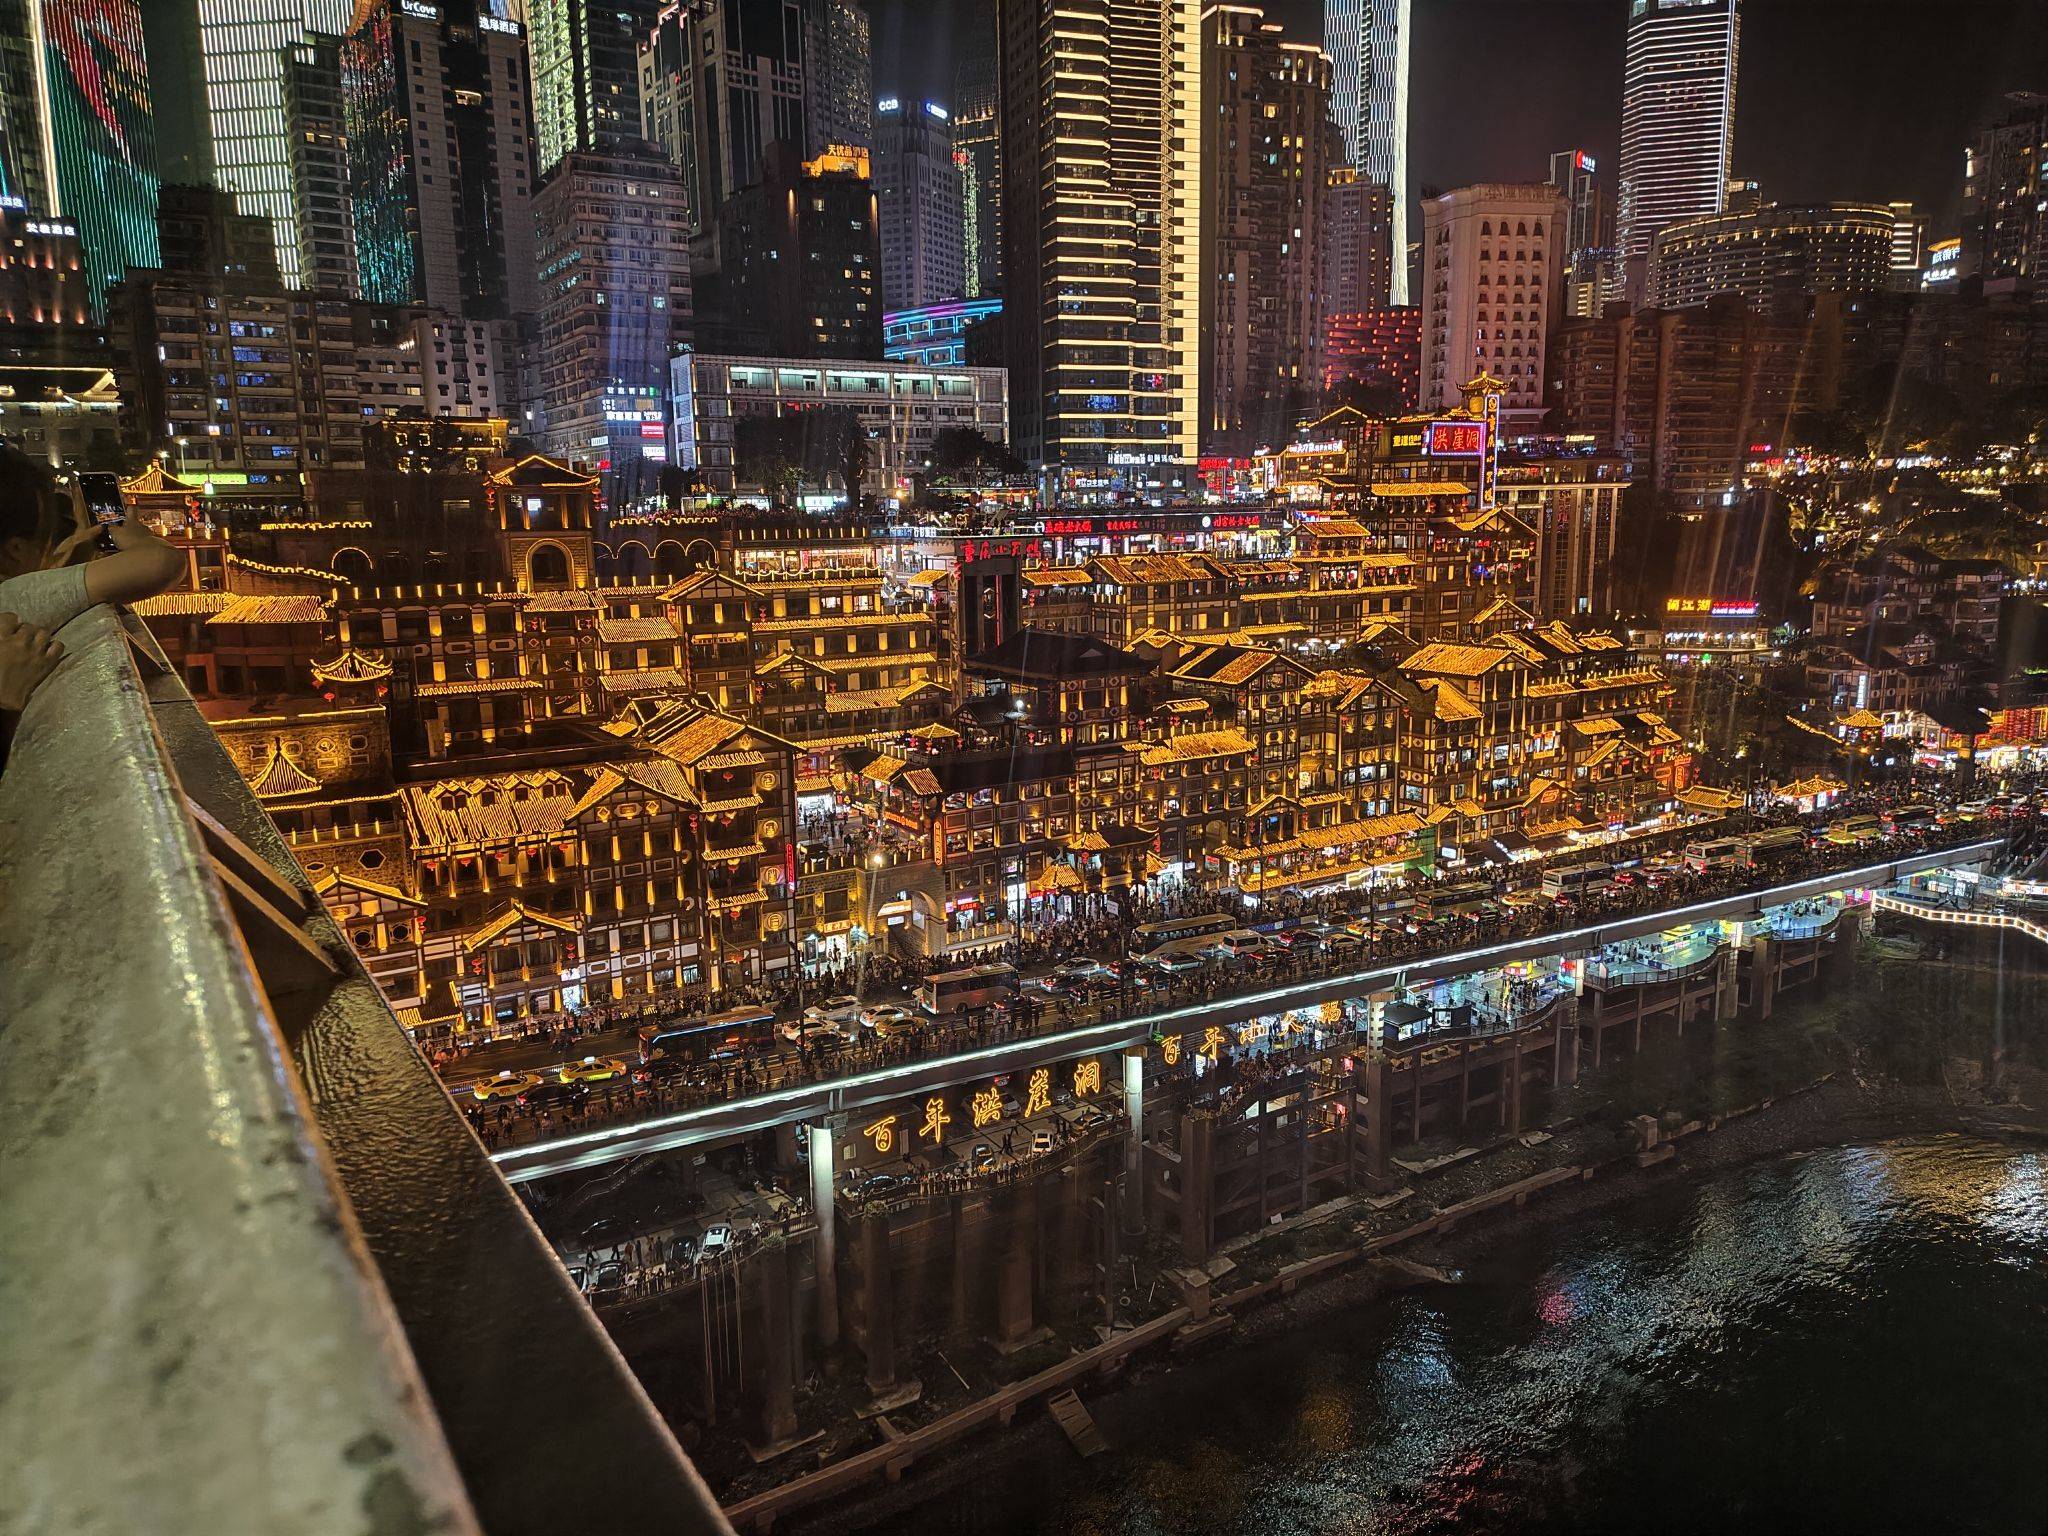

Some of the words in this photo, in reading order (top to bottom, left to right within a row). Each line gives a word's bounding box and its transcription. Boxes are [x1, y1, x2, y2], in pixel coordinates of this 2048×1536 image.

[879, 99, 899, 111] CCB
[1433, 427, 1480, 450] 洪崖洞
[864, 1062, 1101, 1152] 百年洪崖洞
